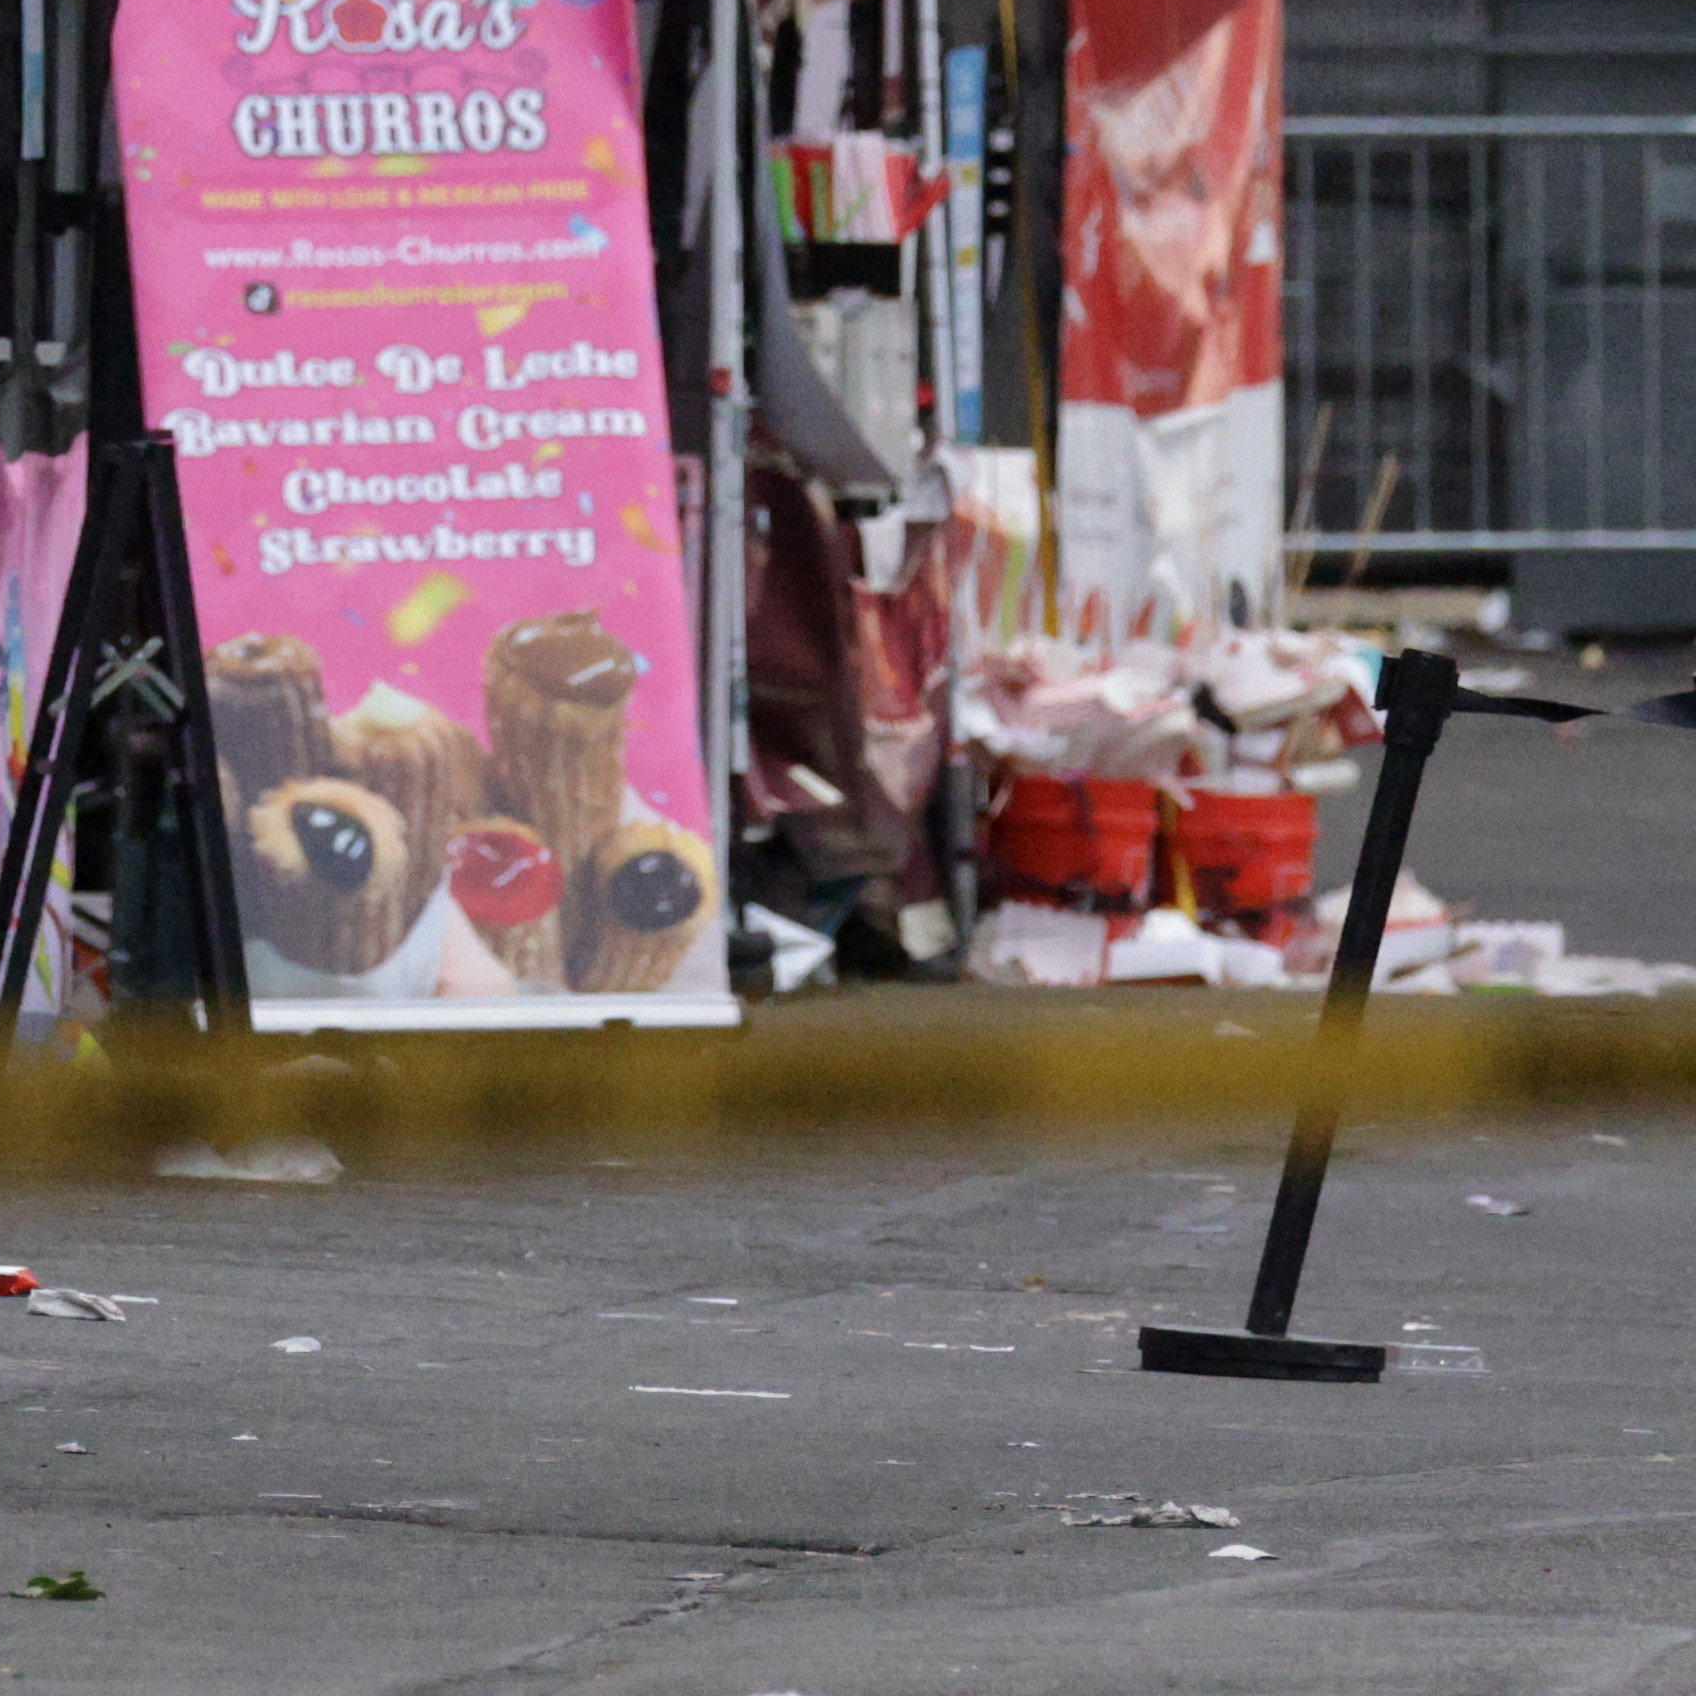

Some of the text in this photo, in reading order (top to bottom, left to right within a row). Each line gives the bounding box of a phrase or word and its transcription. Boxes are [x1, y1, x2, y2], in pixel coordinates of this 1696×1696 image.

[232, 88, 549, 158] CHURROS
[182, 340, 641, 399] Dulce De Leche
[159, 403, 649, 458] Bavarian Cream
[280, 462, 565, 515] Chocolate
[257, 523, 597, 575] Strawberry
